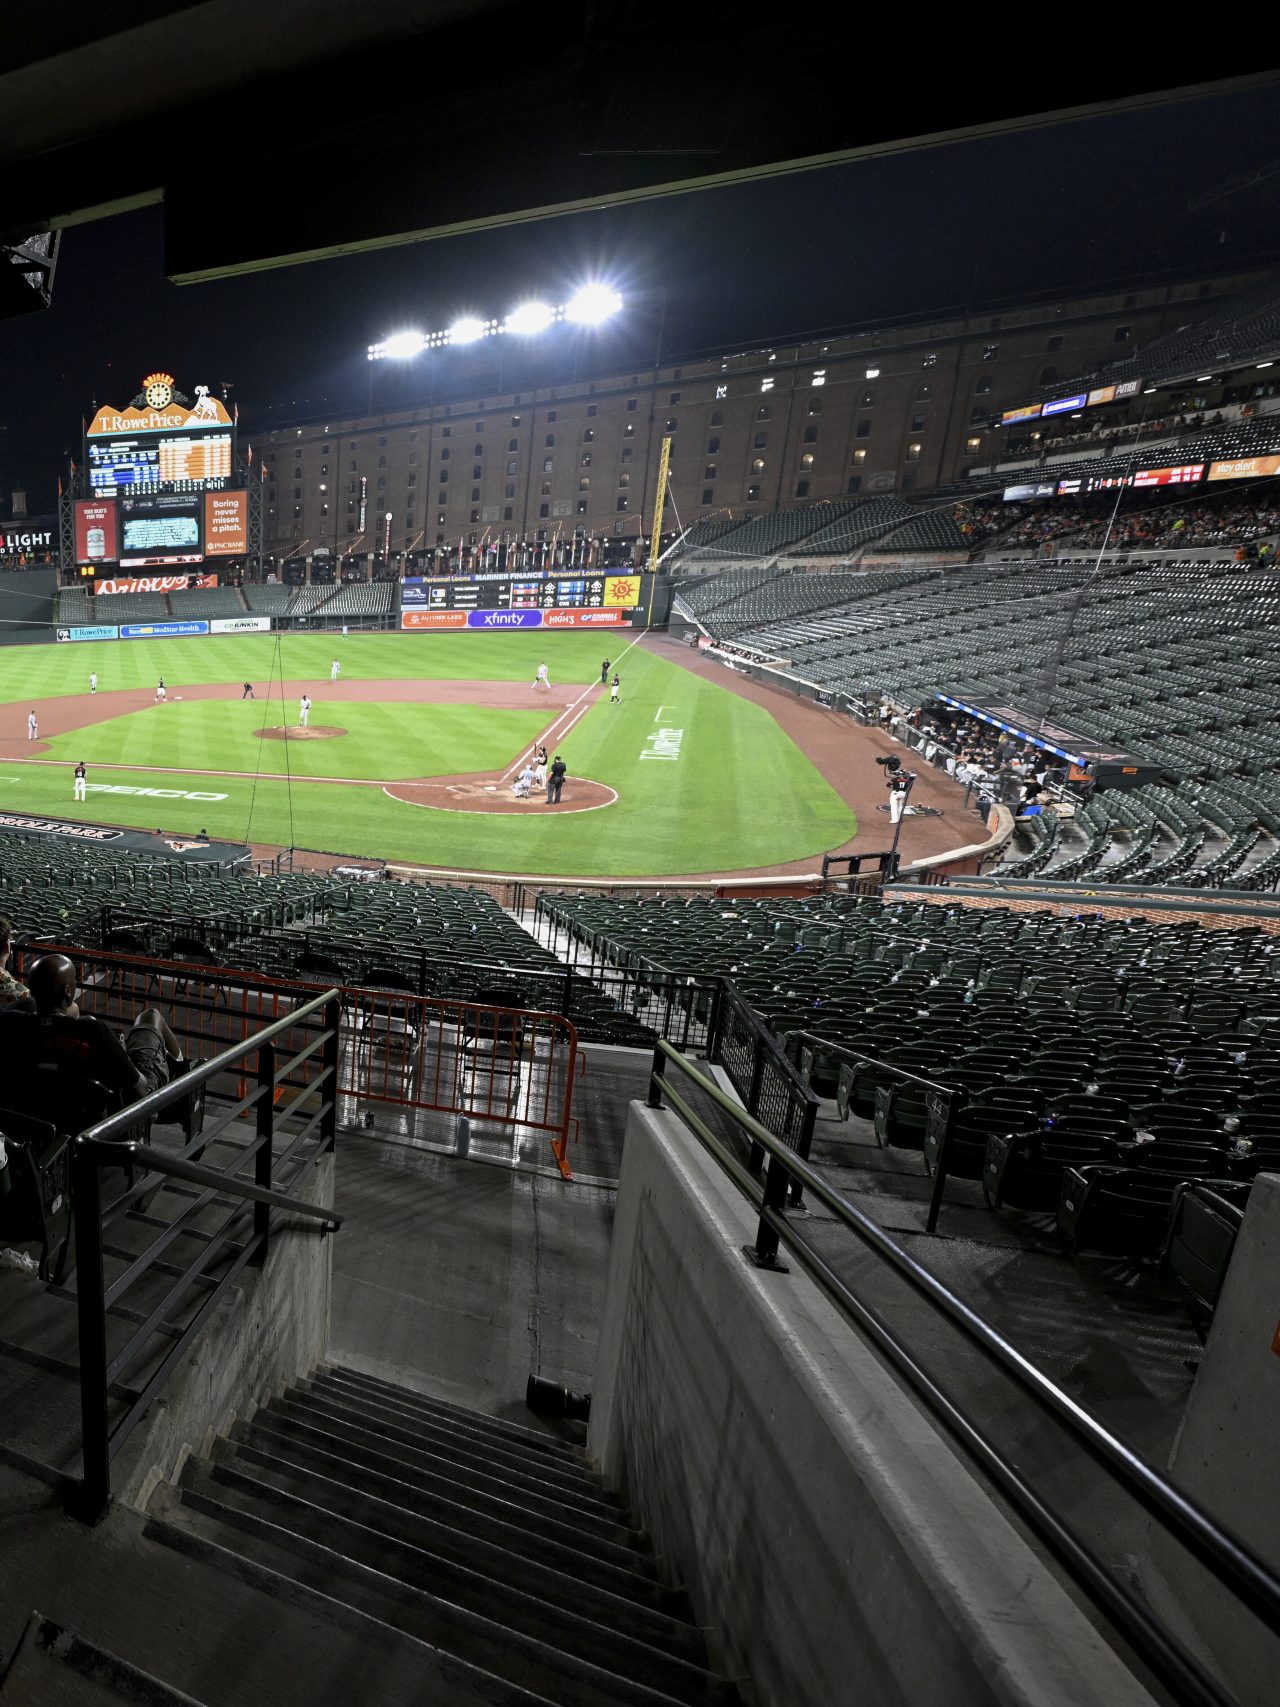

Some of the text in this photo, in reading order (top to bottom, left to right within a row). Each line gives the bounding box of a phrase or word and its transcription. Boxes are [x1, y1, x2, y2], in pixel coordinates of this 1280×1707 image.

[213, 500, 239, 508] Boring
[212, 516, 240, 524] misses
[219, 524, 242, 534] pitch.
[7, 533, 51, 547] LIGHT
[475, 573, 509, 581] MARINER
[510, 572, 543, 580] FINANCE
[548, 570, 581, 578] Personal
[484, 612, 525, 626] xfinity
[549, 615, 574, 624] HIGH'S
[179, 624, 199, 632] Health
[73, 784, 229, 801] GEICO
[53, 825, 113, 839] PARK
